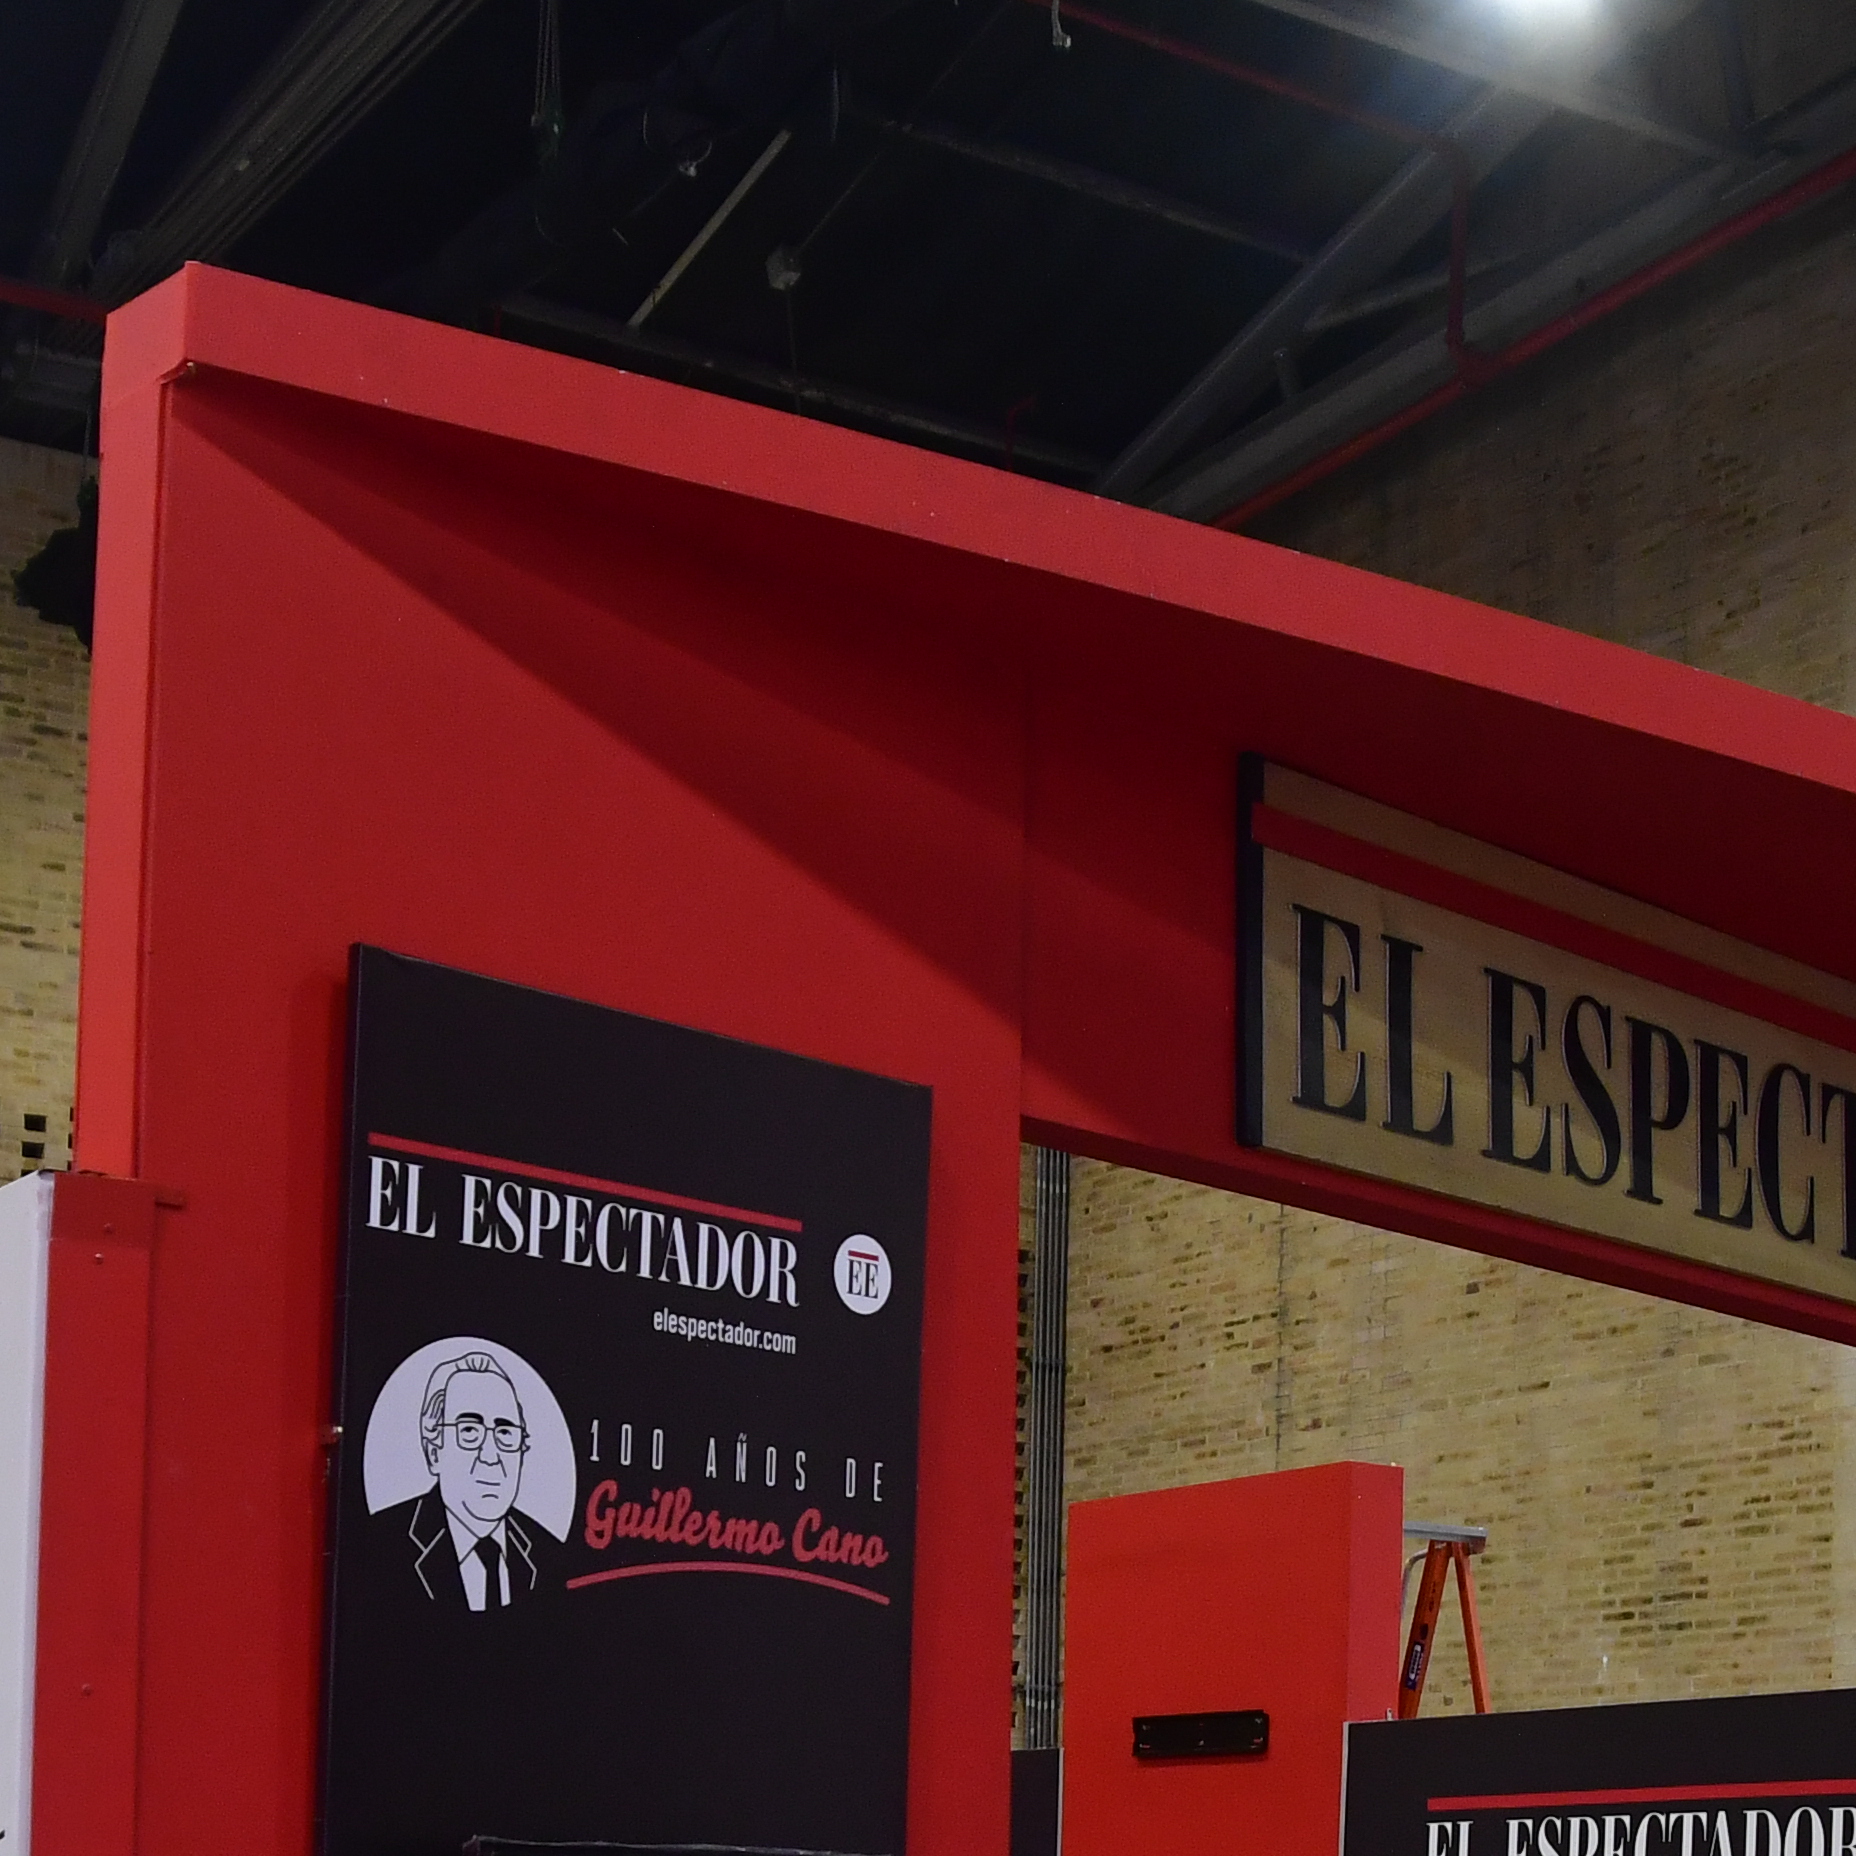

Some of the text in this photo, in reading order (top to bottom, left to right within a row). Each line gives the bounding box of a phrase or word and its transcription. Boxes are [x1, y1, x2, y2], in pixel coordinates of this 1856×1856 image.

[1289, 903, 1453, 1148] EL
[365, 1155, 800, 1307] EL ESPECTADOR
[845, 1260, 879, 1299] EE
[652, 1307, 796, 1354] elespectador.com
[589, 1419, 884, 1502] 100 AÑOS DE
[584, 1478, 889, 1568] Guillermo Cano
